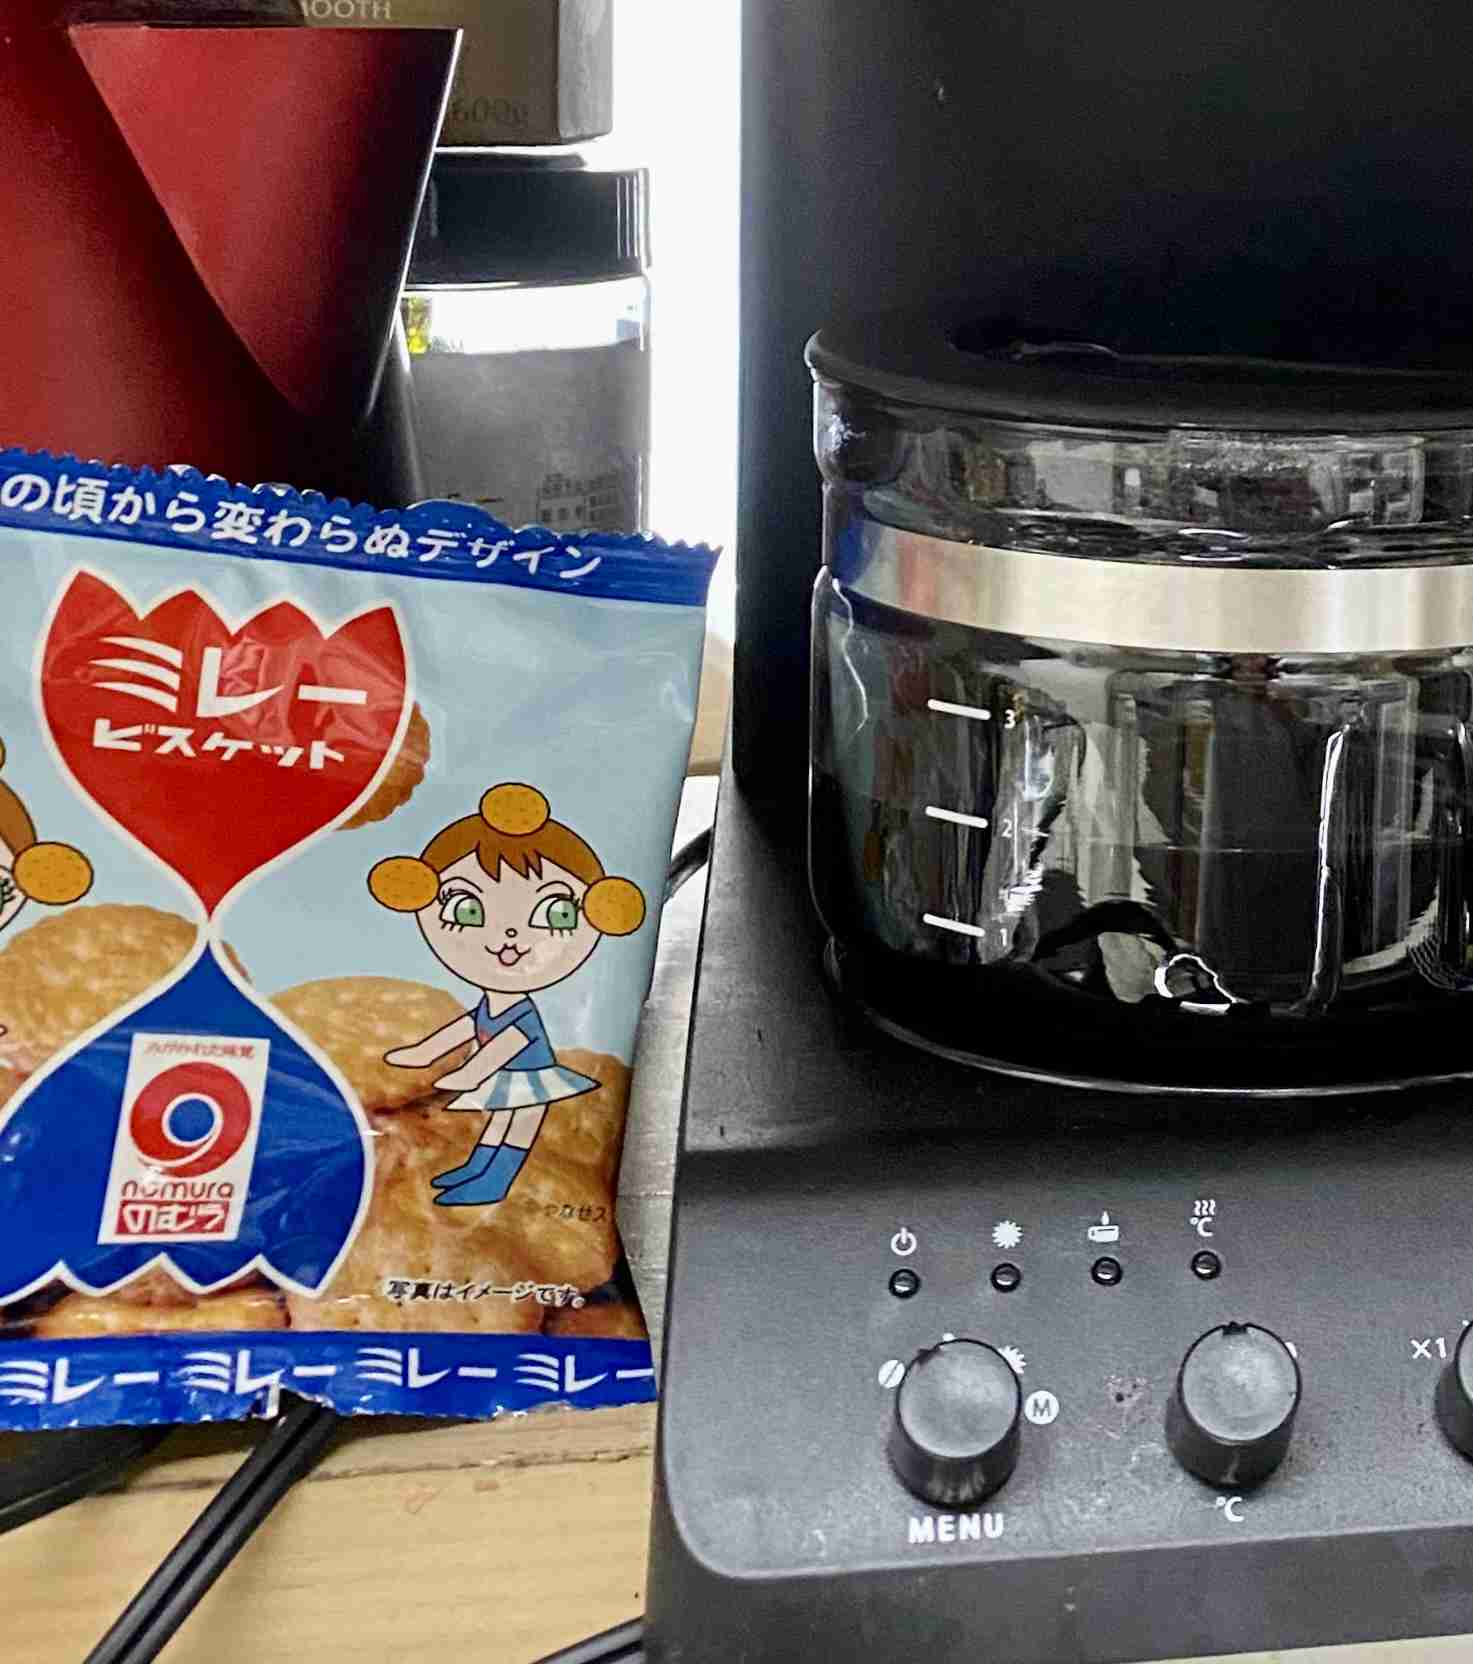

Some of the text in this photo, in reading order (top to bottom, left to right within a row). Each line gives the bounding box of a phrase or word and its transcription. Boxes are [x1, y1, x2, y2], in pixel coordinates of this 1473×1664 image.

[1, 473, 602, 579] の頃から変わらぬデザイン
[88, 637, 368, 718] ミレー
[1003, 709, 1016, 729] 3
[92, 717, 345, 770] ビスケット
[1002, 818, 1013, 838] 2
[387, 1279, 586, 1310] 写真はイメージです。
[0, 1347, 655, 1404] ミレー ミレー ミレー ミレー
[908, 1513, 1006, 1544] MENU
